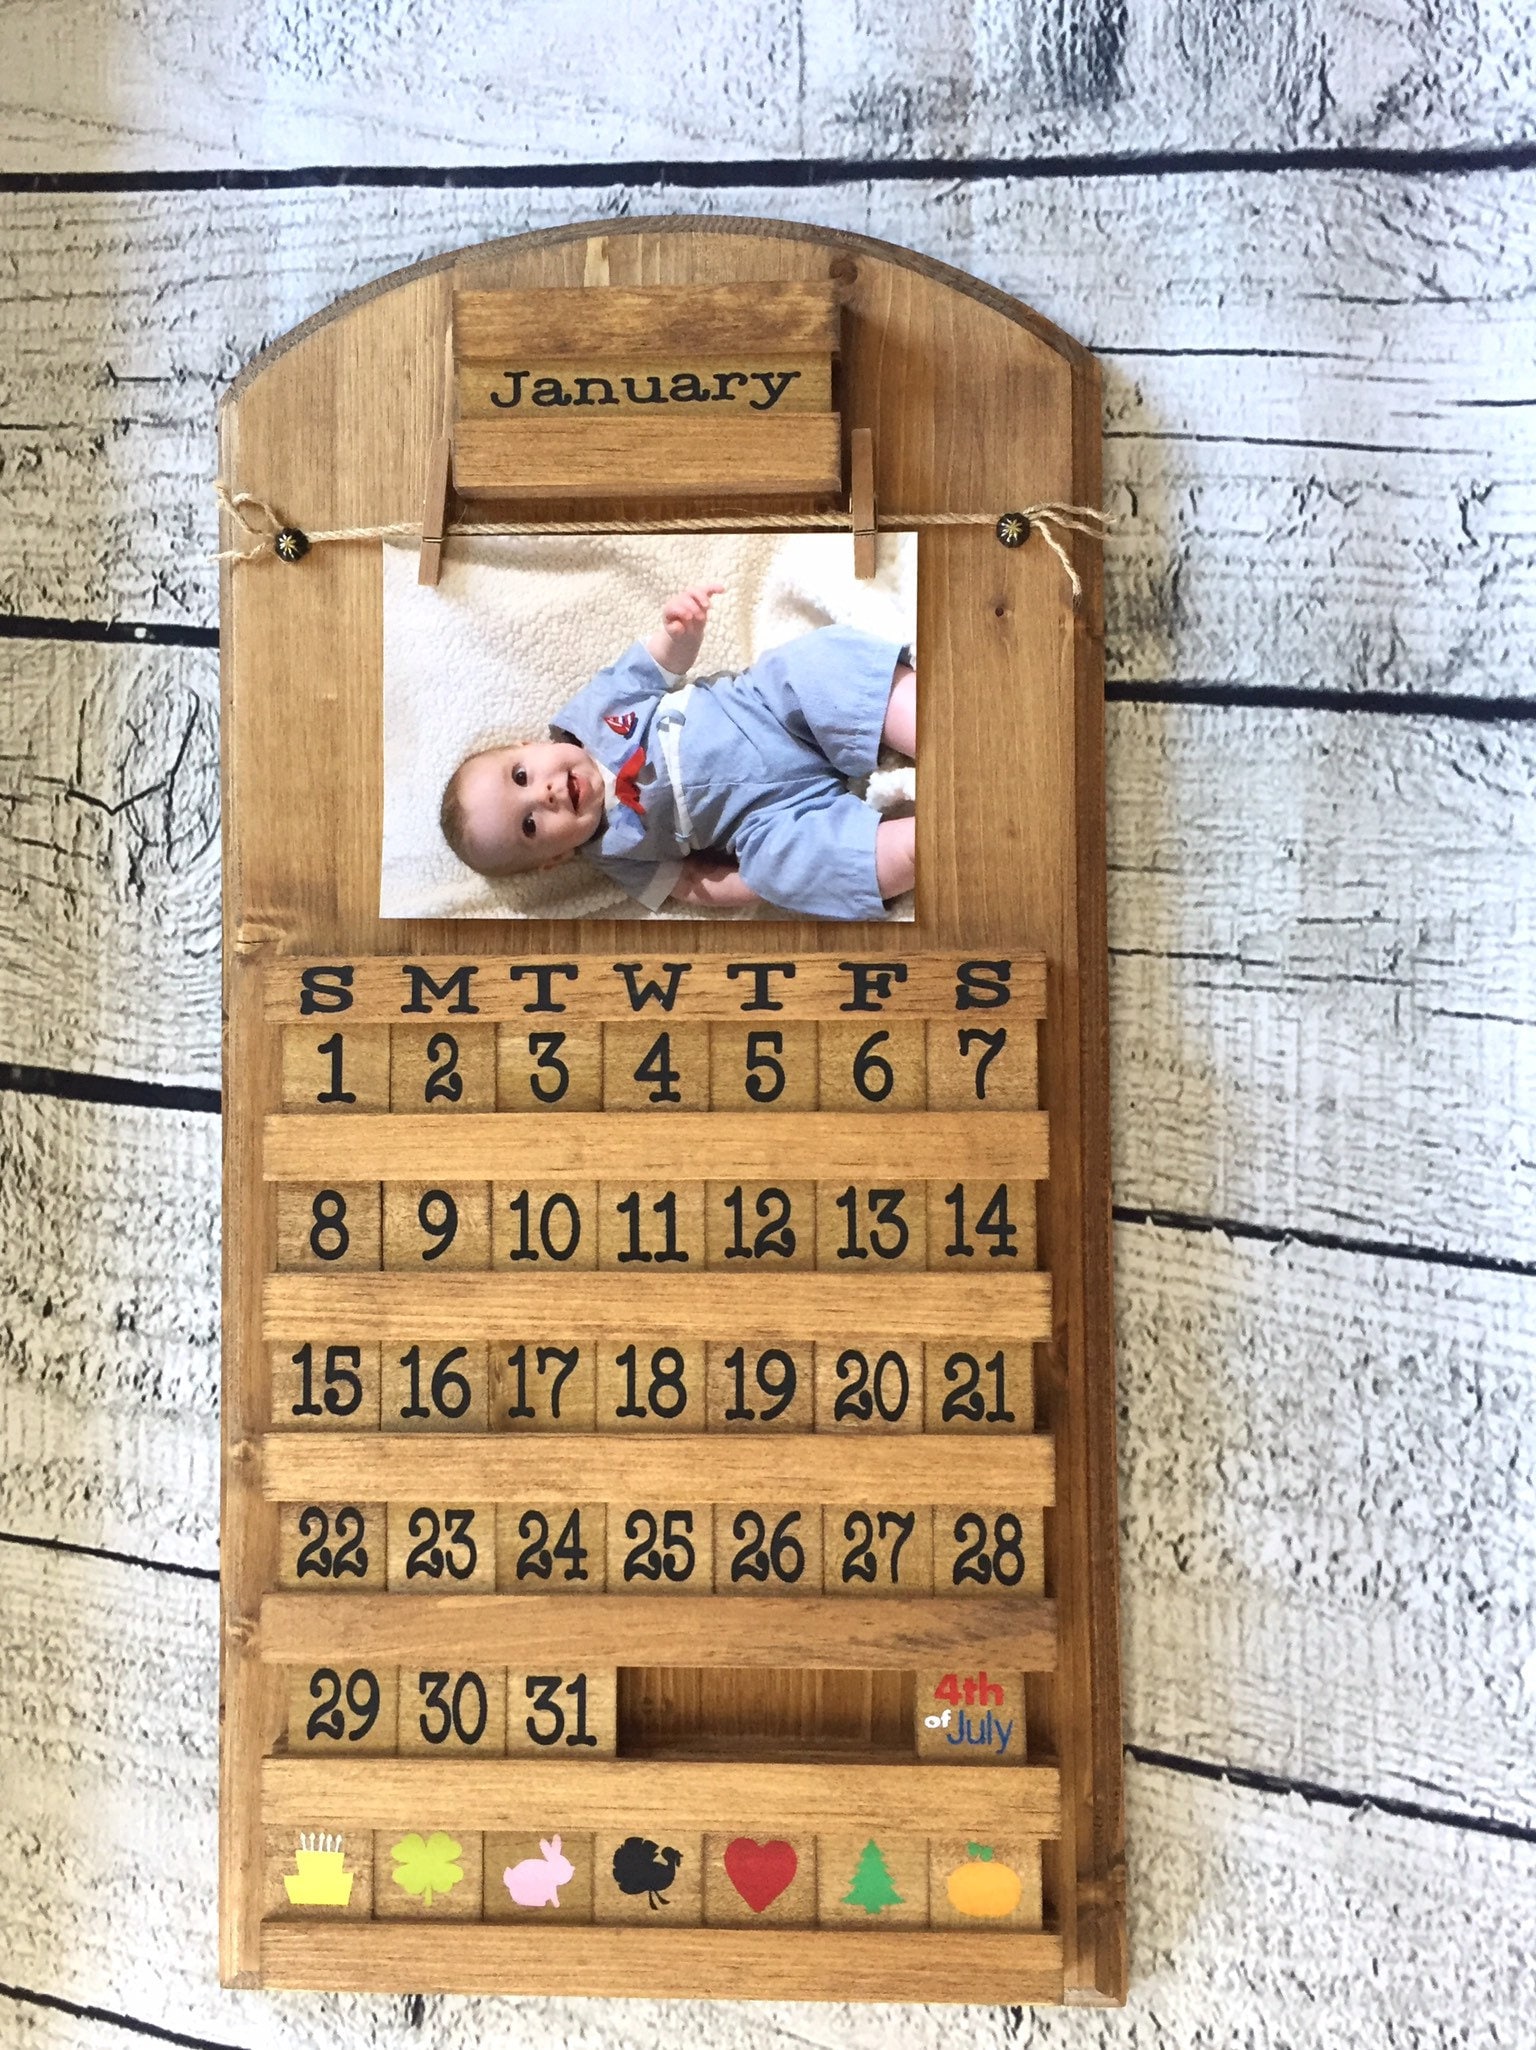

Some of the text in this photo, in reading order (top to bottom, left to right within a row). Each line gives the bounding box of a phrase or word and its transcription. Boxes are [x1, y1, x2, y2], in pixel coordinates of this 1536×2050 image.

[491, 371, 801, 410] January
[300, 960, 1011, 1014] S M T W T F S
[317, 1028, 1006, 1103] 1 2 3 4 5 6 7
[310, 1183, 1018, 1262] 8 9 10 11 12 13 14
[292, 1343, 1015, 1422] 15 16 17 18 19 20 21
[297, 1506, 1024, 1586] 22 23 24 25 26 27 28
[307, 1668, 596, 1746] 29 30 31
[934, 1671, 1005, 1706] 4th
[924, 1709, 1013, 1755] of July
